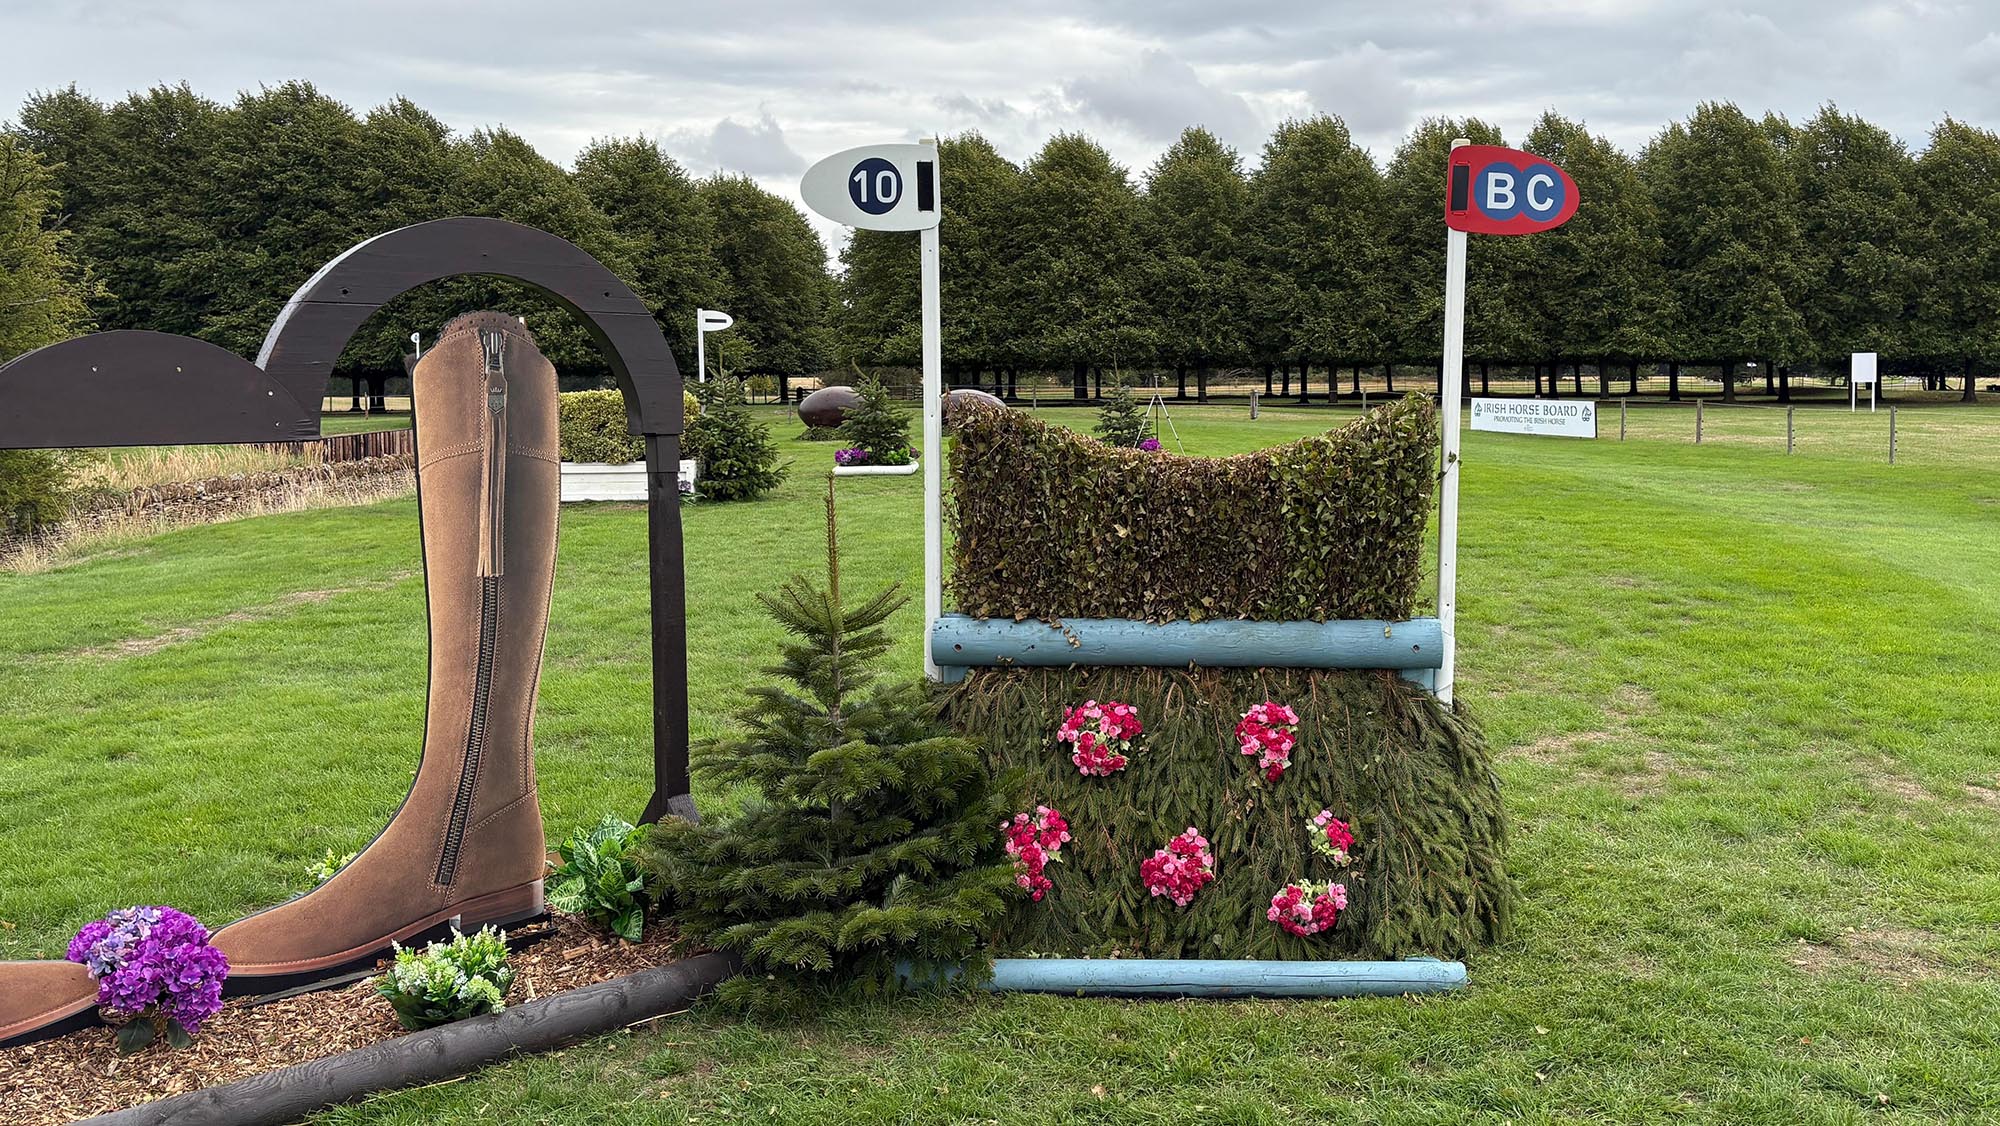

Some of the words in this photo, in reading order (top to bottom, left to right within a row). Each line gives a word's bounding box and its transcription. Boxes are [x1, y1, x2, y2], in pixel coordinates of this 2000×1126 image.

[853, 170, 898, 204] 10
[1483, 402, 1507, 414] IRISH
[1508, 403, 1540, 416] HORSE
[1543, 404, 1578, 417] BOARD
[1493, 415, 1523, 424] PROMOTING
[1523, 416, 1533, 424] THE
[1534, 417, 1547, 425] IRISH
[1548, 417, 1566, 426] HORSE
